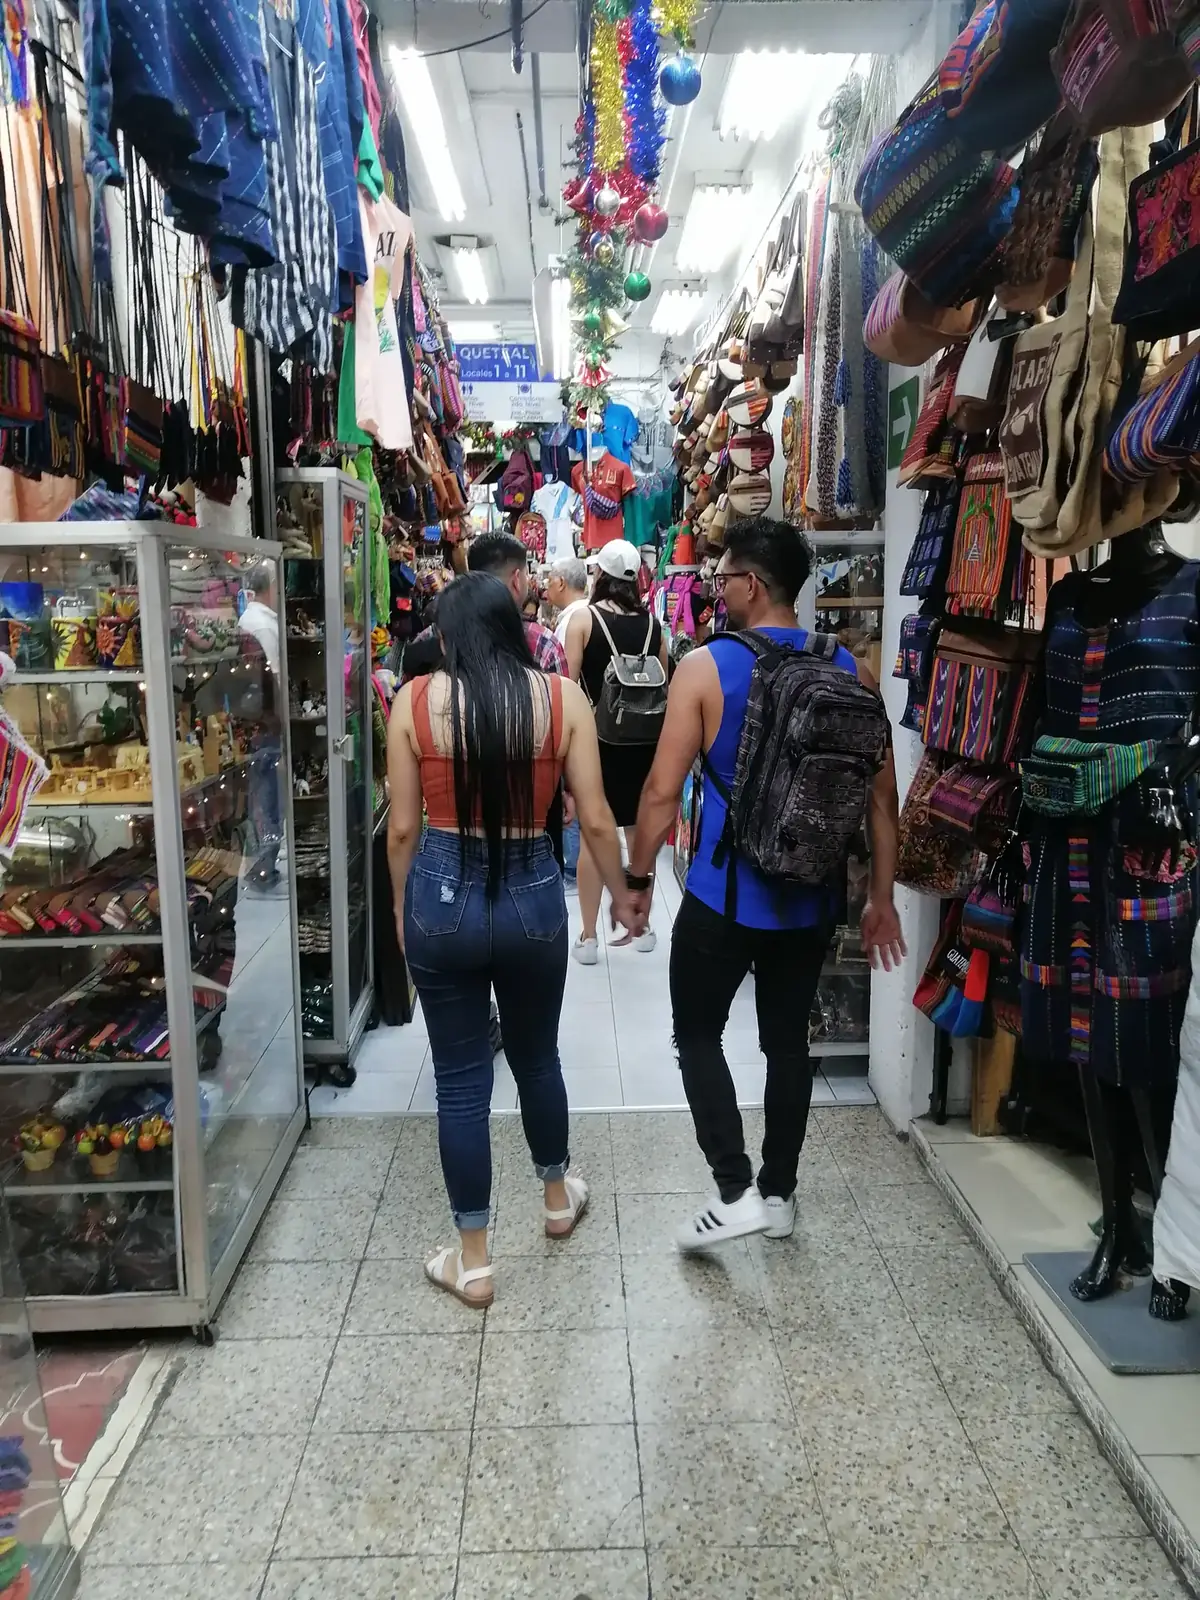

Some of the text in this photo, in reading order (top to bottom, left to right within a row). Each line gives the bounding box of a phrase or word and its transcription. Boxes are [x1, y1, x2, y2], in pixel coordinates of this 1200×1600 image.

[461, 369, 493, 378] Locales
[494, 364, 500, 378] 1
[514, 364, 526, 378] 11
